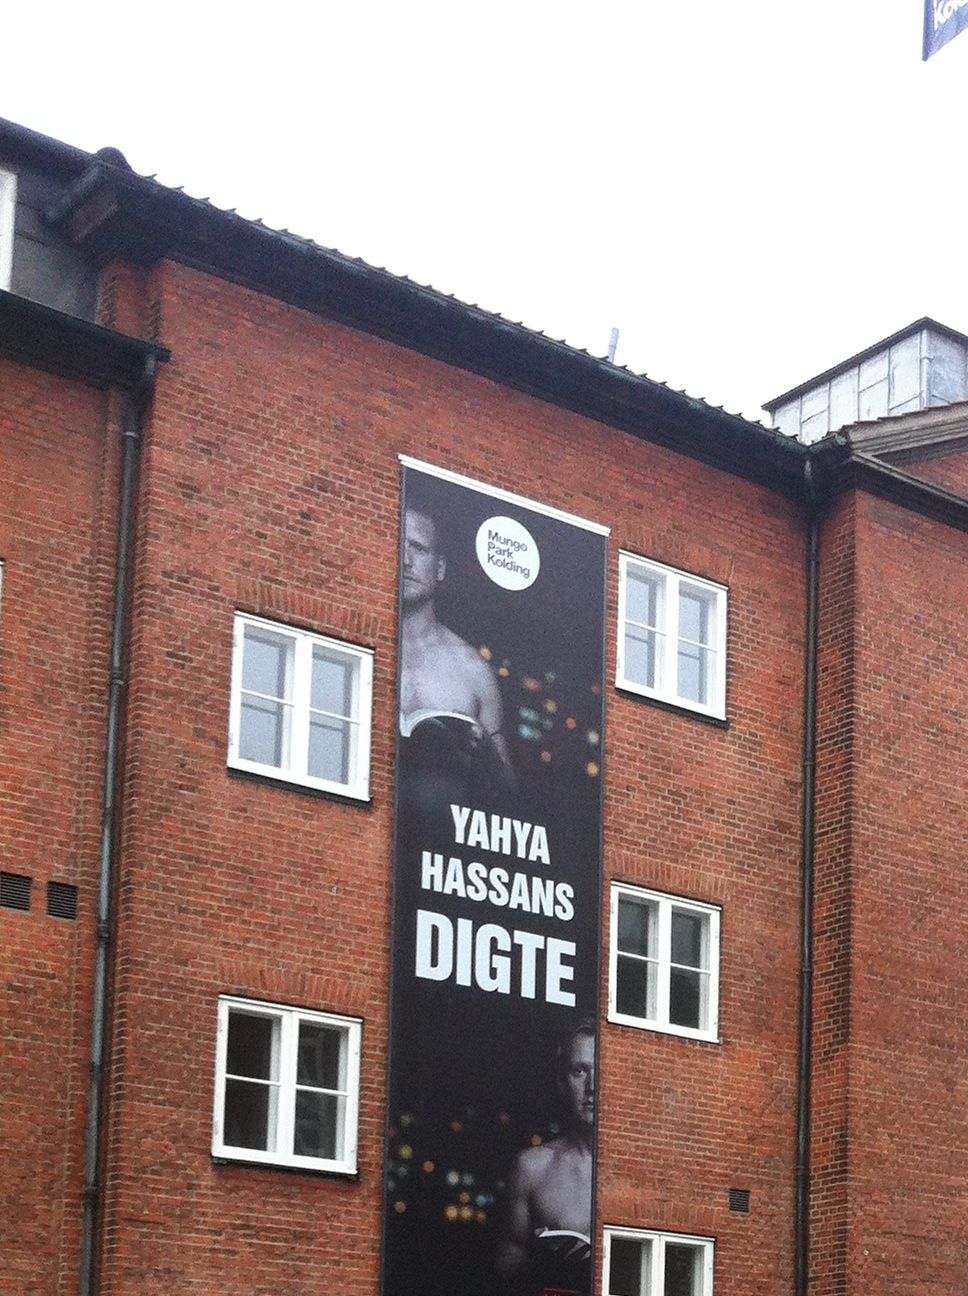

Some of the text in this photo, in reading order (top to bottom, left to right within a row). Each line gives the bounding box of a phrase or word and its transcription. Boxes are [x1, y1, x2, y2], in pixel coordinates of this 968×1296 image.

[487, 541, 514, 559] Park
[488, 530, 528, 552] Mungo
[487, 553, 531, 579] Kolding
[450, 804, 551, 865] YAHYA
[421, 851, 574, 921] HASSANS
[415, 909, 576, 1007] DIGTE
